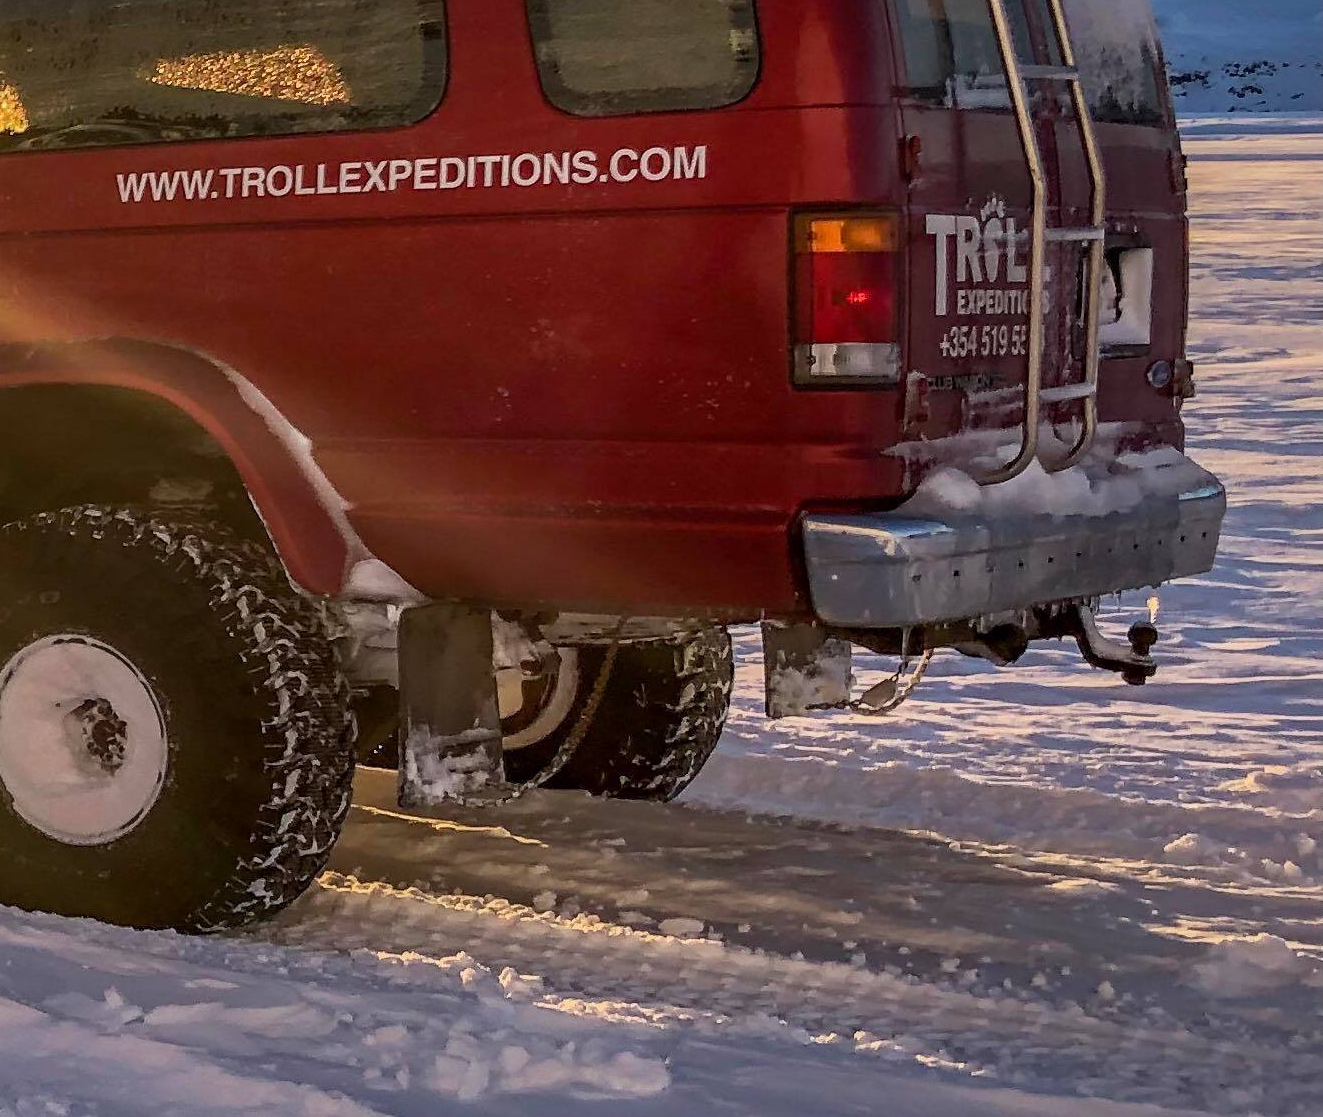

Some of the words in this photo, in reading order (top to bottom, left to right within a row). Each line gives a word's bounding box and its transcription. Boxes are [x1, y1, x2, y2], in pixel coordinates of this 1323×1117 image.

[116, 145, 707, 203] WWW.TROLLEXPEDITIONS.COM
[925, 213, 1051, 316] TROL
[957, 289, 1051, 314] EXPEDITIS
[939, 325, 978, 357] +354
[981, 325, 1008, 356] 519
